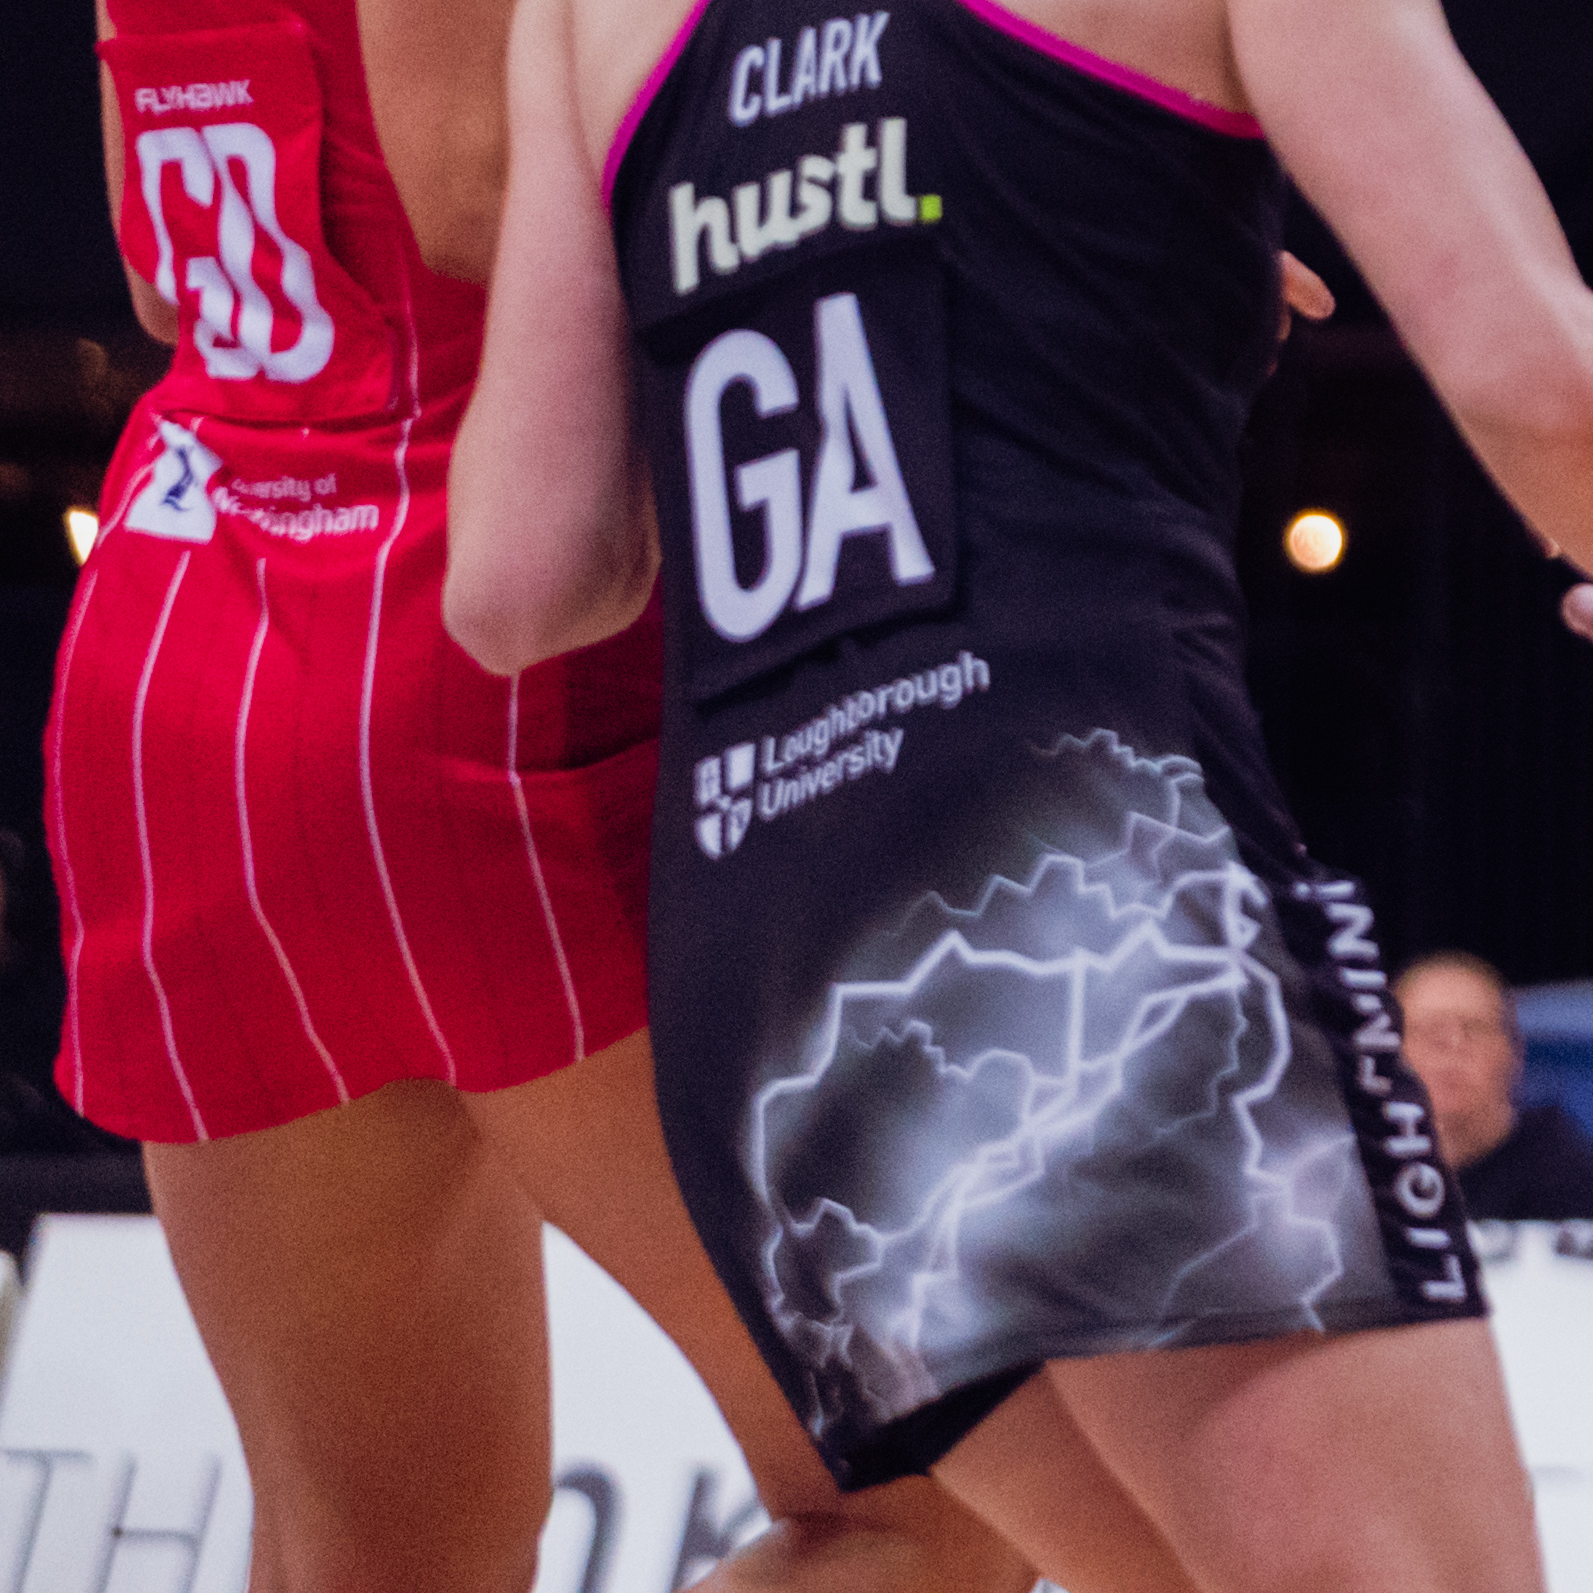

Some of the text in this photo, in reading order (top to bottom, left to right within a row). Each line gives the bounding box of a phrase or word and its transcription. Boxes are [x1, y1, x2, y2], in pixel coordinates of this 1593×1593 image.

[728, 11, 890, 128] CLARK
[683, 291, 937, 644] GA
[762, 649, 991, 774] Loughborough
[757, 727, 905, 822] University
